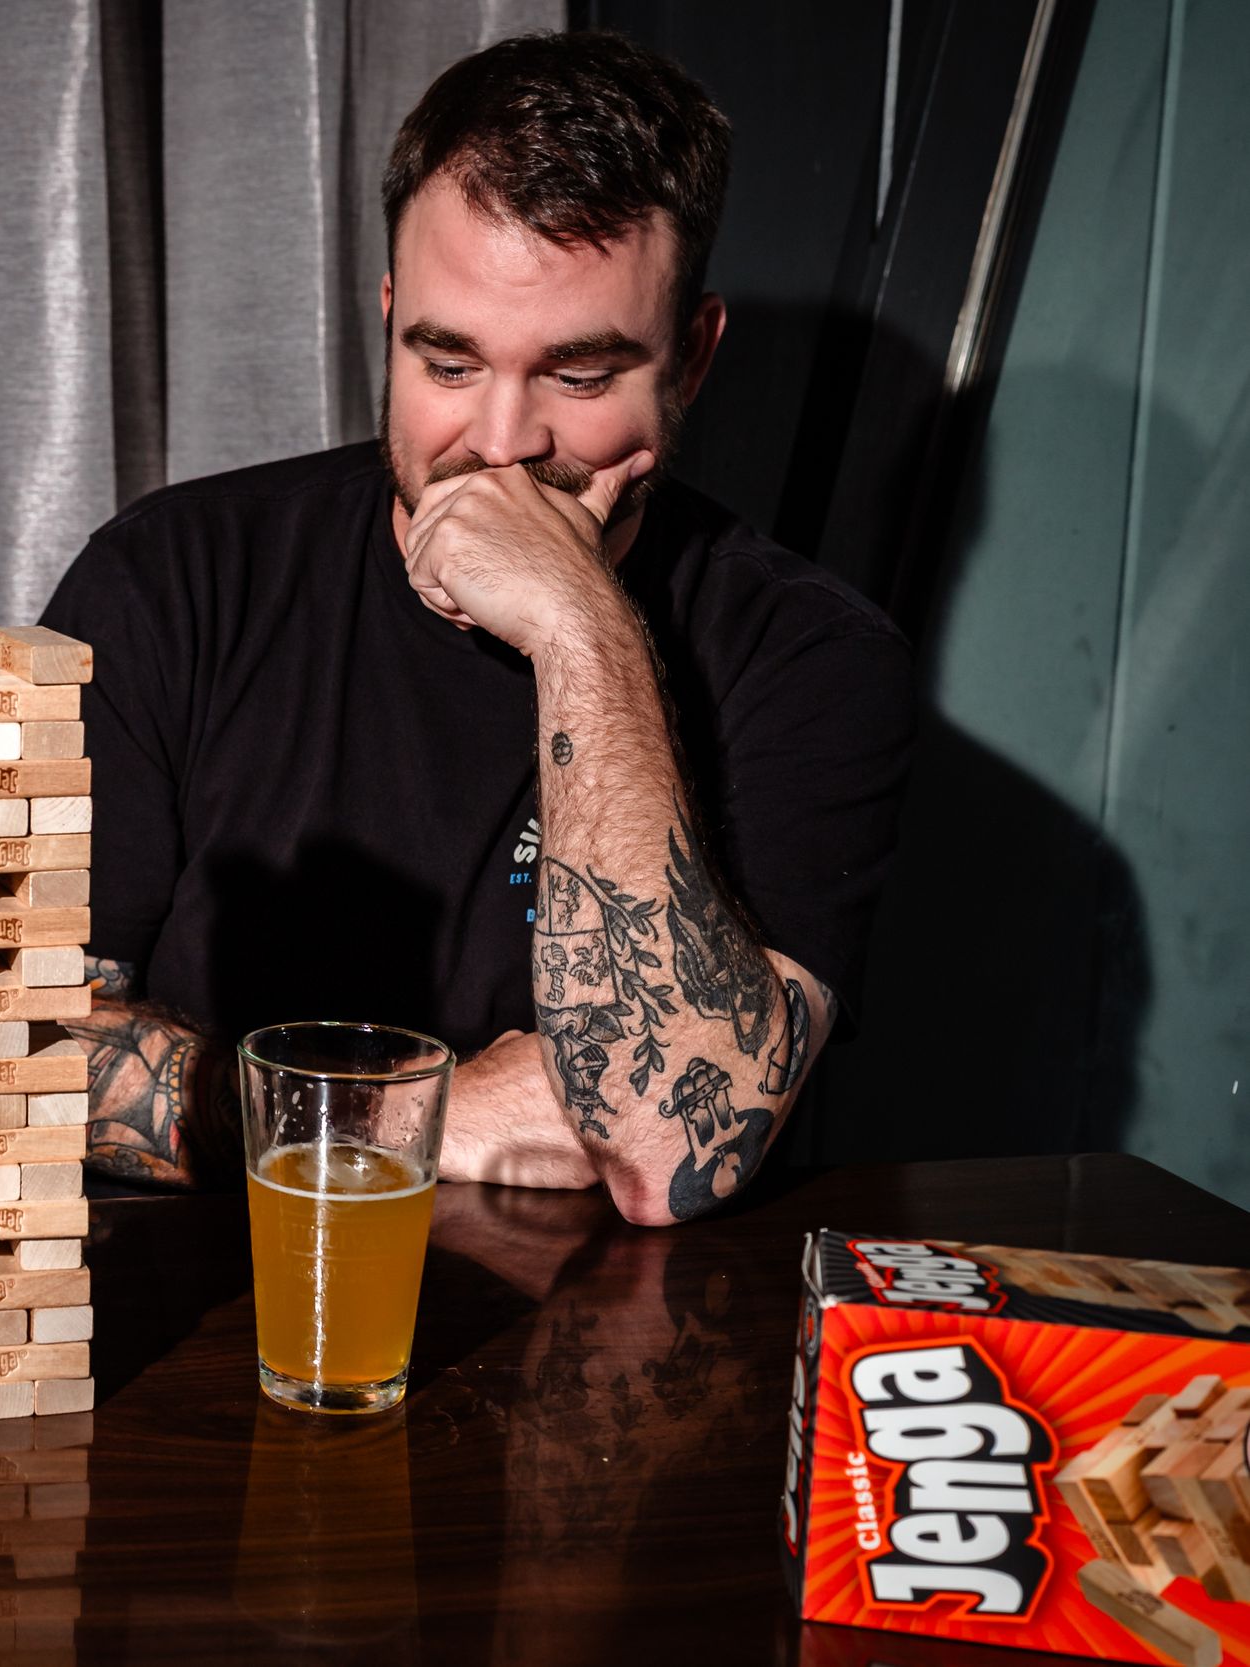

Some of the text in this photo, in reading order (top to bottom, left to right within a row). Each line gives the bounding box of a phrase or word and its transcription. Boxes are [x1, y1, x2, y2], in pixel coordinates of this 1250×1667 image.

[510, 873, 533, 885] EST.
[855, 1242, 990, 1312] Jenga
[852, 1345, 1032, 1614] Jenga
